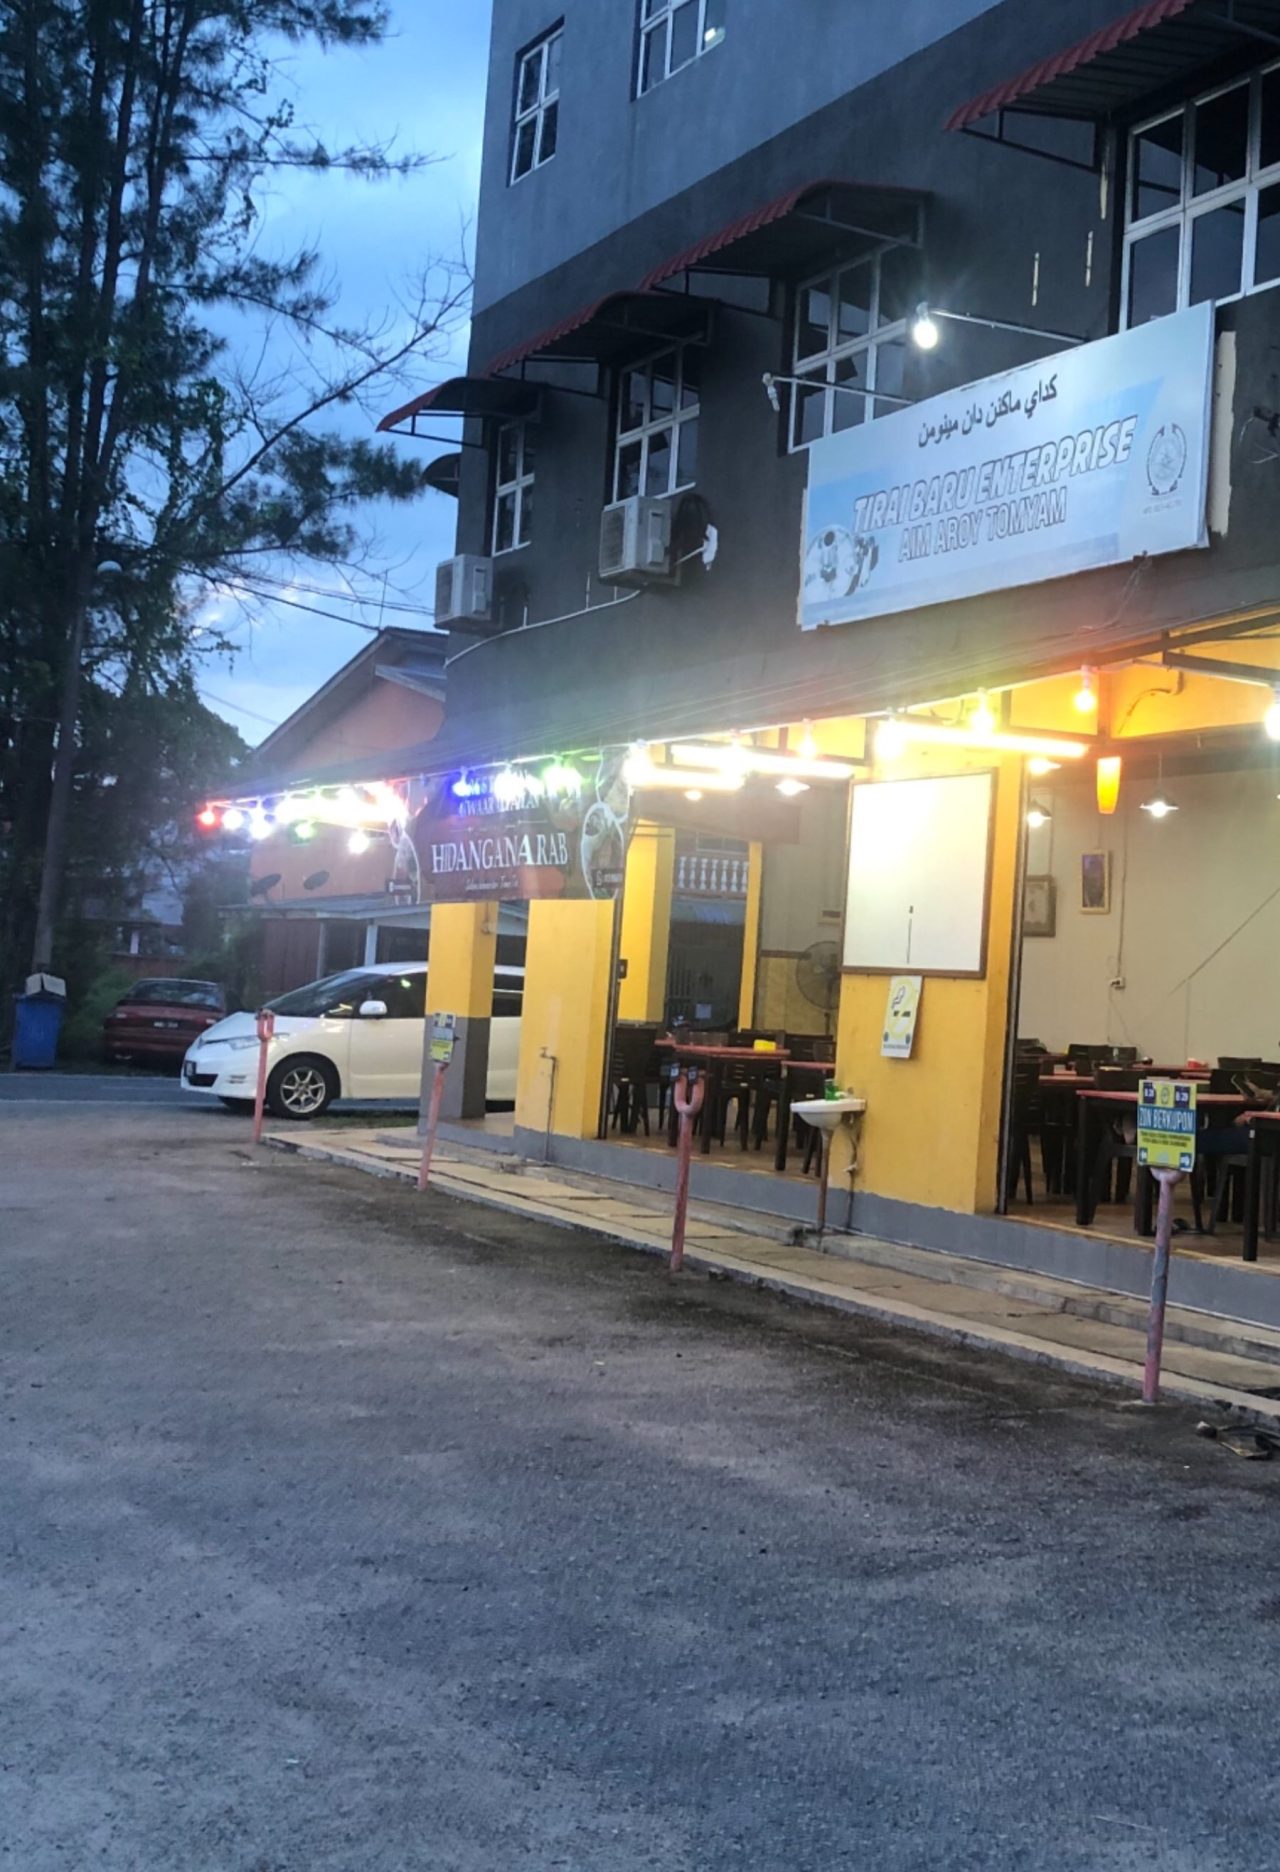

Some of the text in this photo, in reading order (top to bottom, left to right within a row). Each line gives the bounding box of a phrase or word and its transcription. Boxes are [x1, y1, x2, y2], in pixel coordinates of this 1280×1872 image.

[962, 403, 982, 435] دان
[853, 415, 1138, 533] TIRAI BARU ENTERPRISE
[898, 486, 1067, 563] AIM AROY TOMYAM
[431, 832, 568, 873] HIDANGAN ARAB
